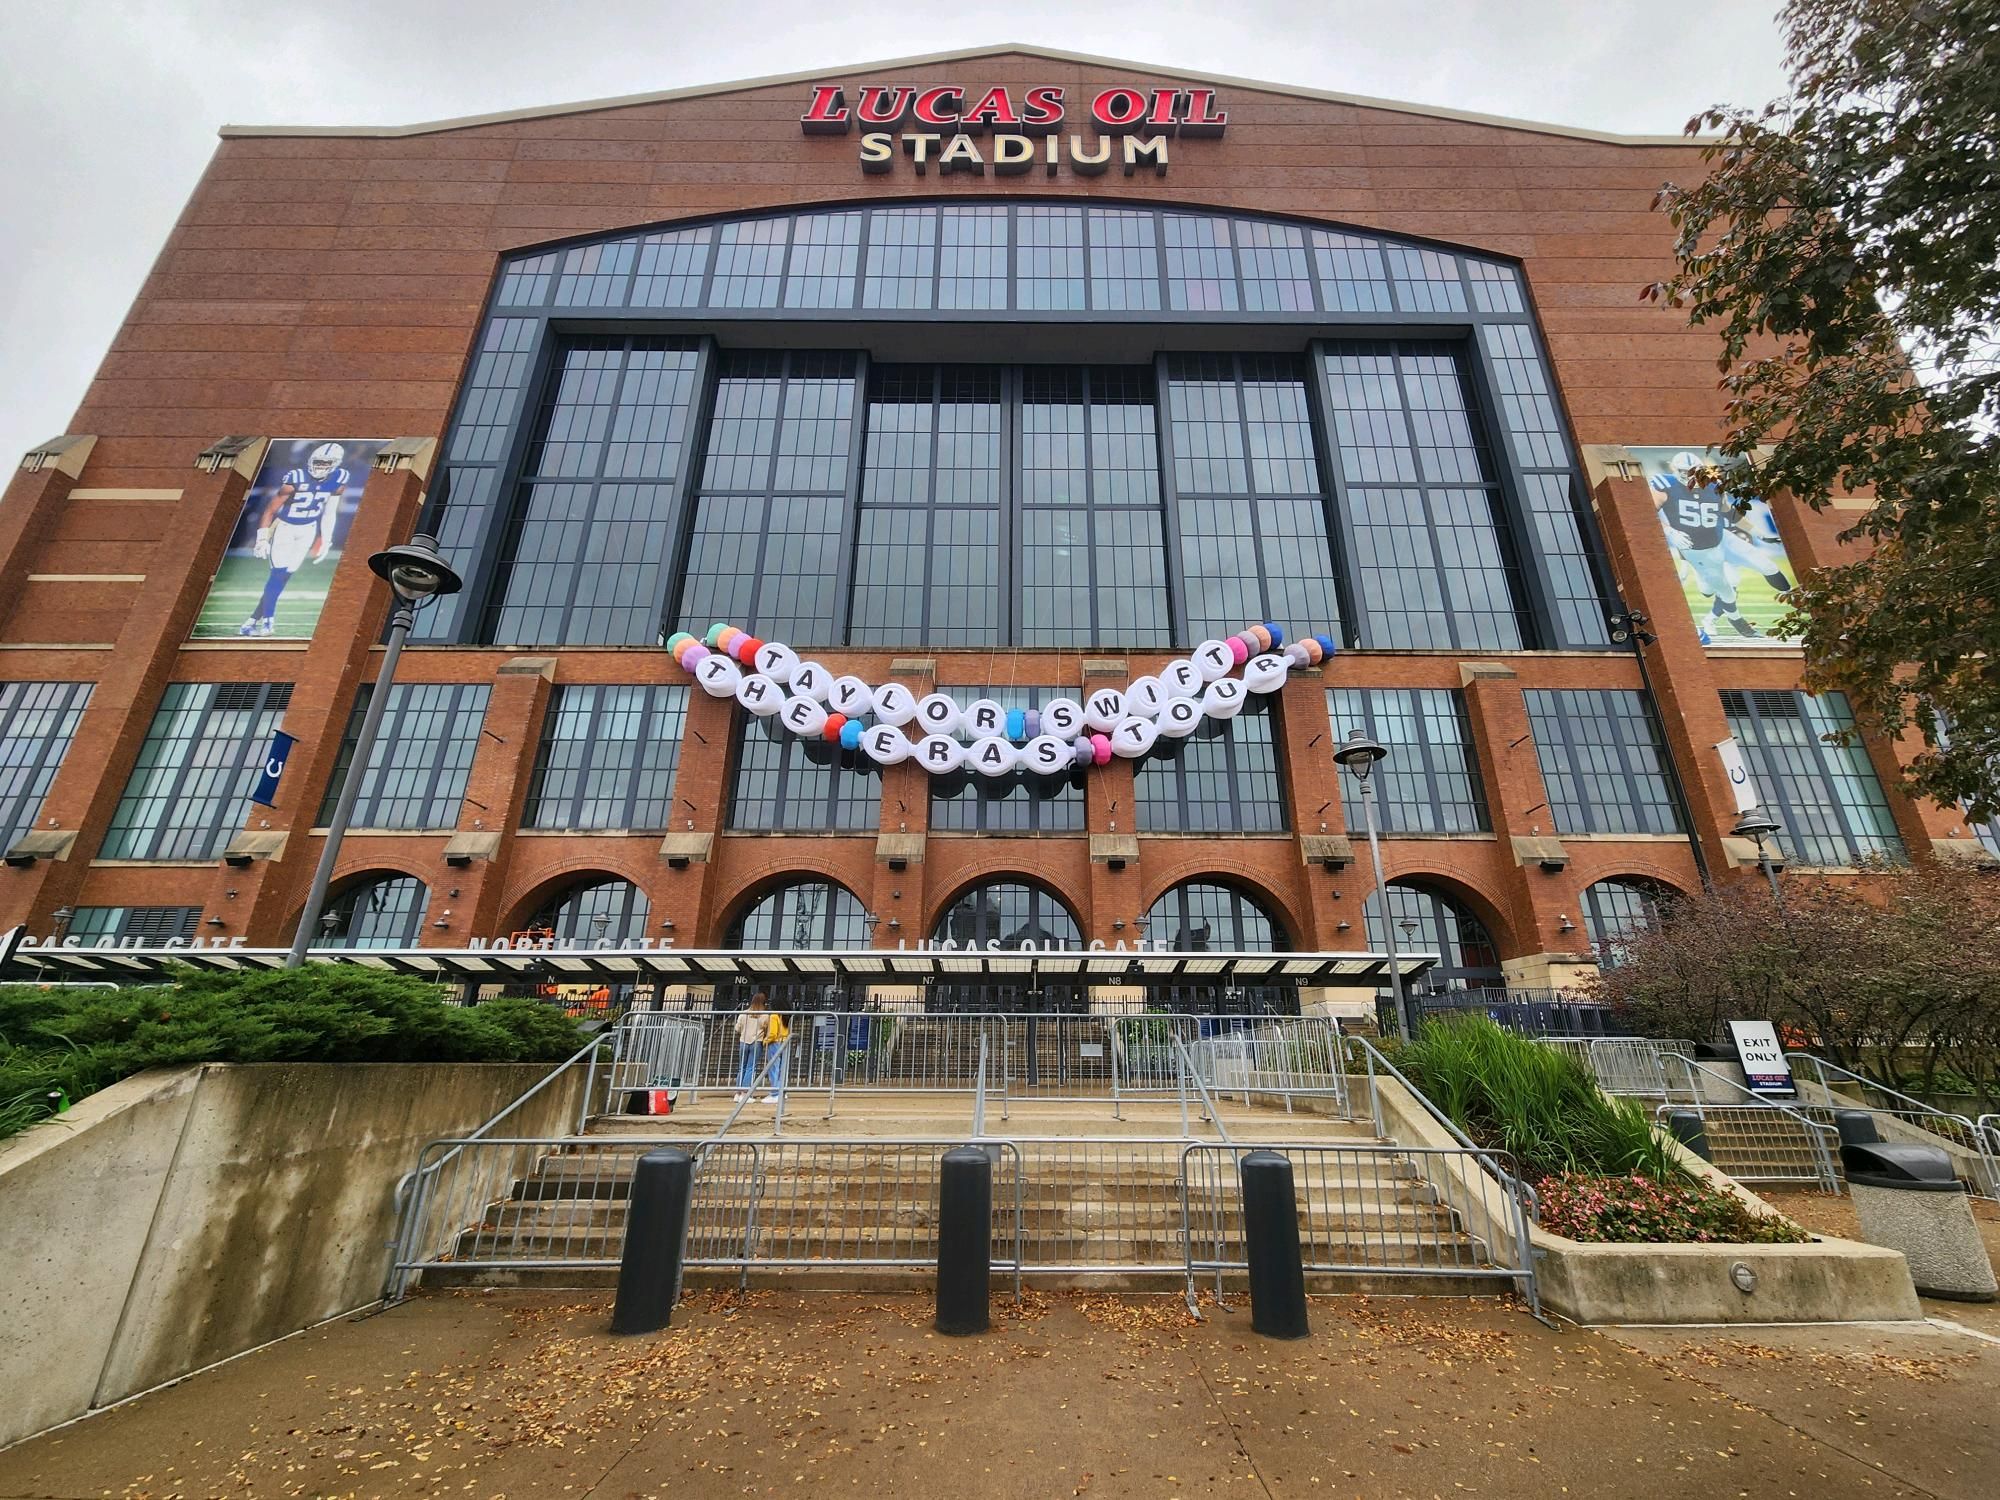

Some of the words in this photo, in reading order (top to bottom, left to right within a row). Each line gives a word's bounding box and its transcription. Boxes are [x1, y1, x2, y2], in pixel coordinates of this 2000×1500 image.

[799, 85, 1066, 129] LUCAS
[1091, 86, 1229, 131] OIL
[860, 132, 1169, 168] STADIUM
[1678, 499, 1720, 528] 56
[761, 648, 997, 727] TAYLOR
[1052, 645, 1226, 727] SWIFT
[704, 659, 808, 726] THE
[873, 731, 1058, 764] ERAS
[1123, 656, 1279, 742] TOUR
[467, 937, 577, 951] NORTH
[593, 937, 675, 951] GATE
[1089, 938, 1169, 952] GATE
[734, 975, 748, 985] N6
[922, 976, 935, 985] N7
[1108, 976, 1122, 986] N8
[1295, 977, 1309, 986] N9
[1743, 1038, 1771, 1047] EXIT
[1745, 1052, 1777, 1062] ONLY
